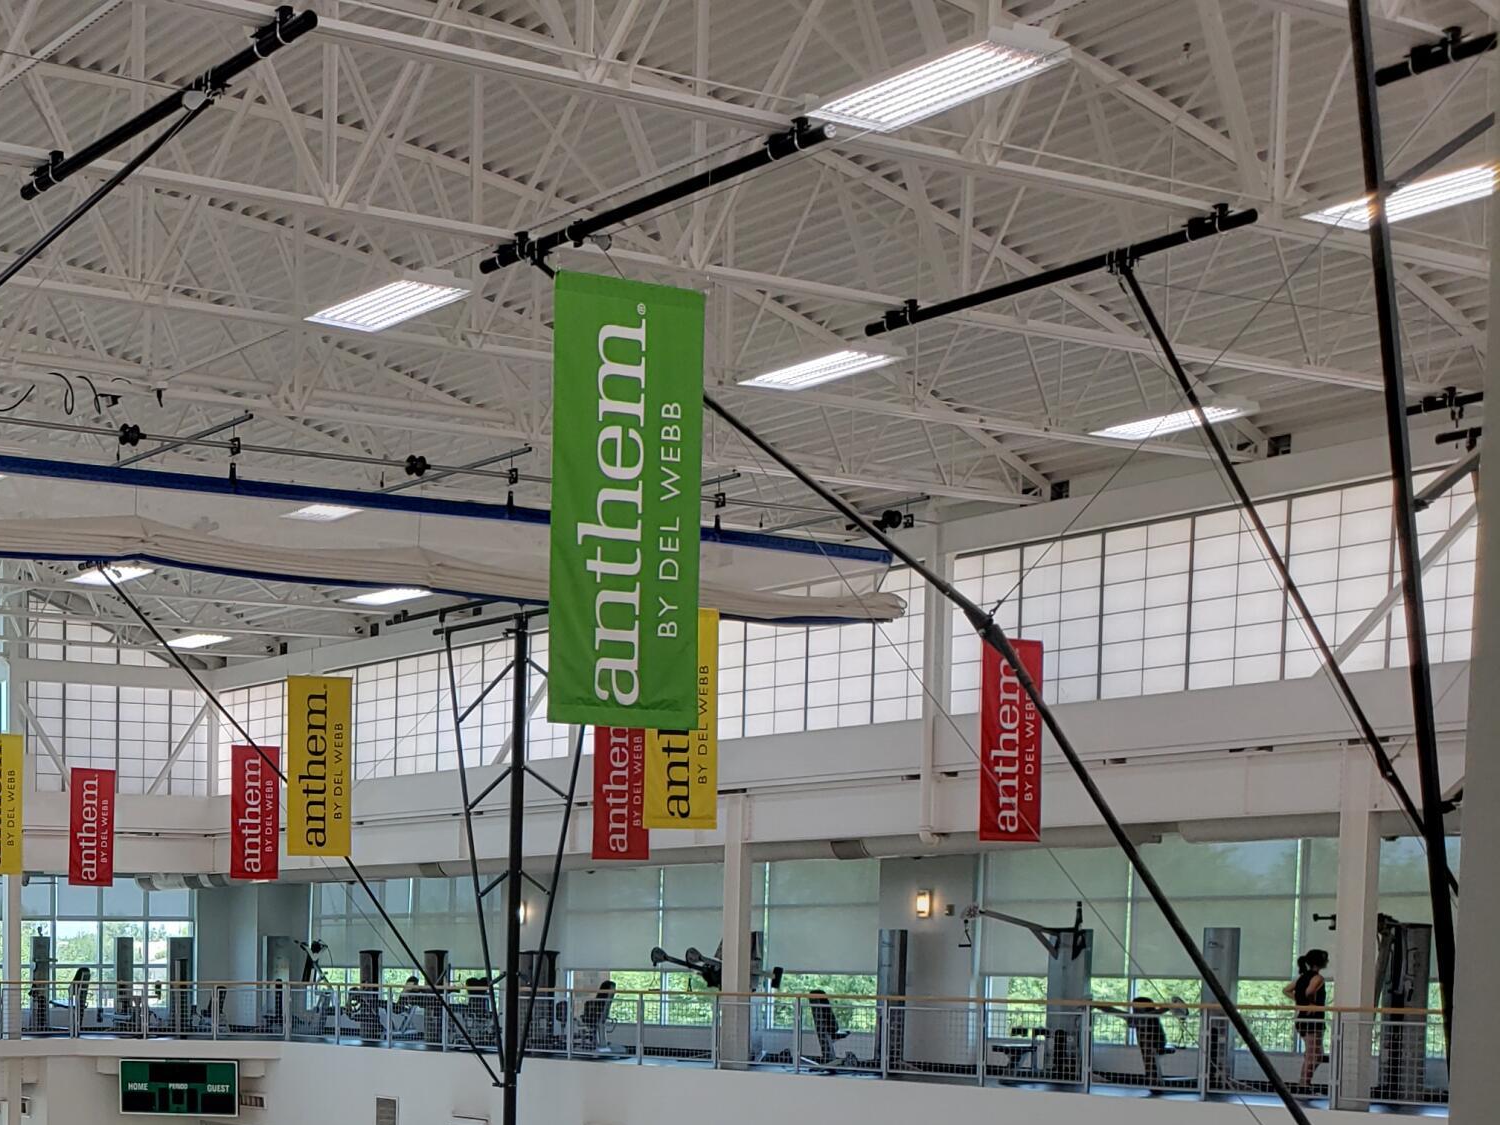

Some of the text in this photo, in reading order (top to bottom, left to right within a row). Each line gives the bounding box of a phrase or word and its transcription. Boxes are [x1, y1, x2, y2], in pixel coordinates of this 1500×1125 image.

[657, 401, 683, 639] BY DEL WEBB
[698, 665, 709, 784] BY DEL WEBB
[333, 723, 344, 820] BY DEL WEBB
[1024, 744, 1034, 775] DEL
[633, 736, 643, 826] BY DEL WEBB
[1024, 783, 1033, 801] BY
[7, 770, 15, 846] BY DEL WEBB
[101, 851, 107, 863] BY
[265, 836, 272, 853] BY
[128, 1082, 148, 1090] HOME
[207, 1084, 230, 1092] GUEST
